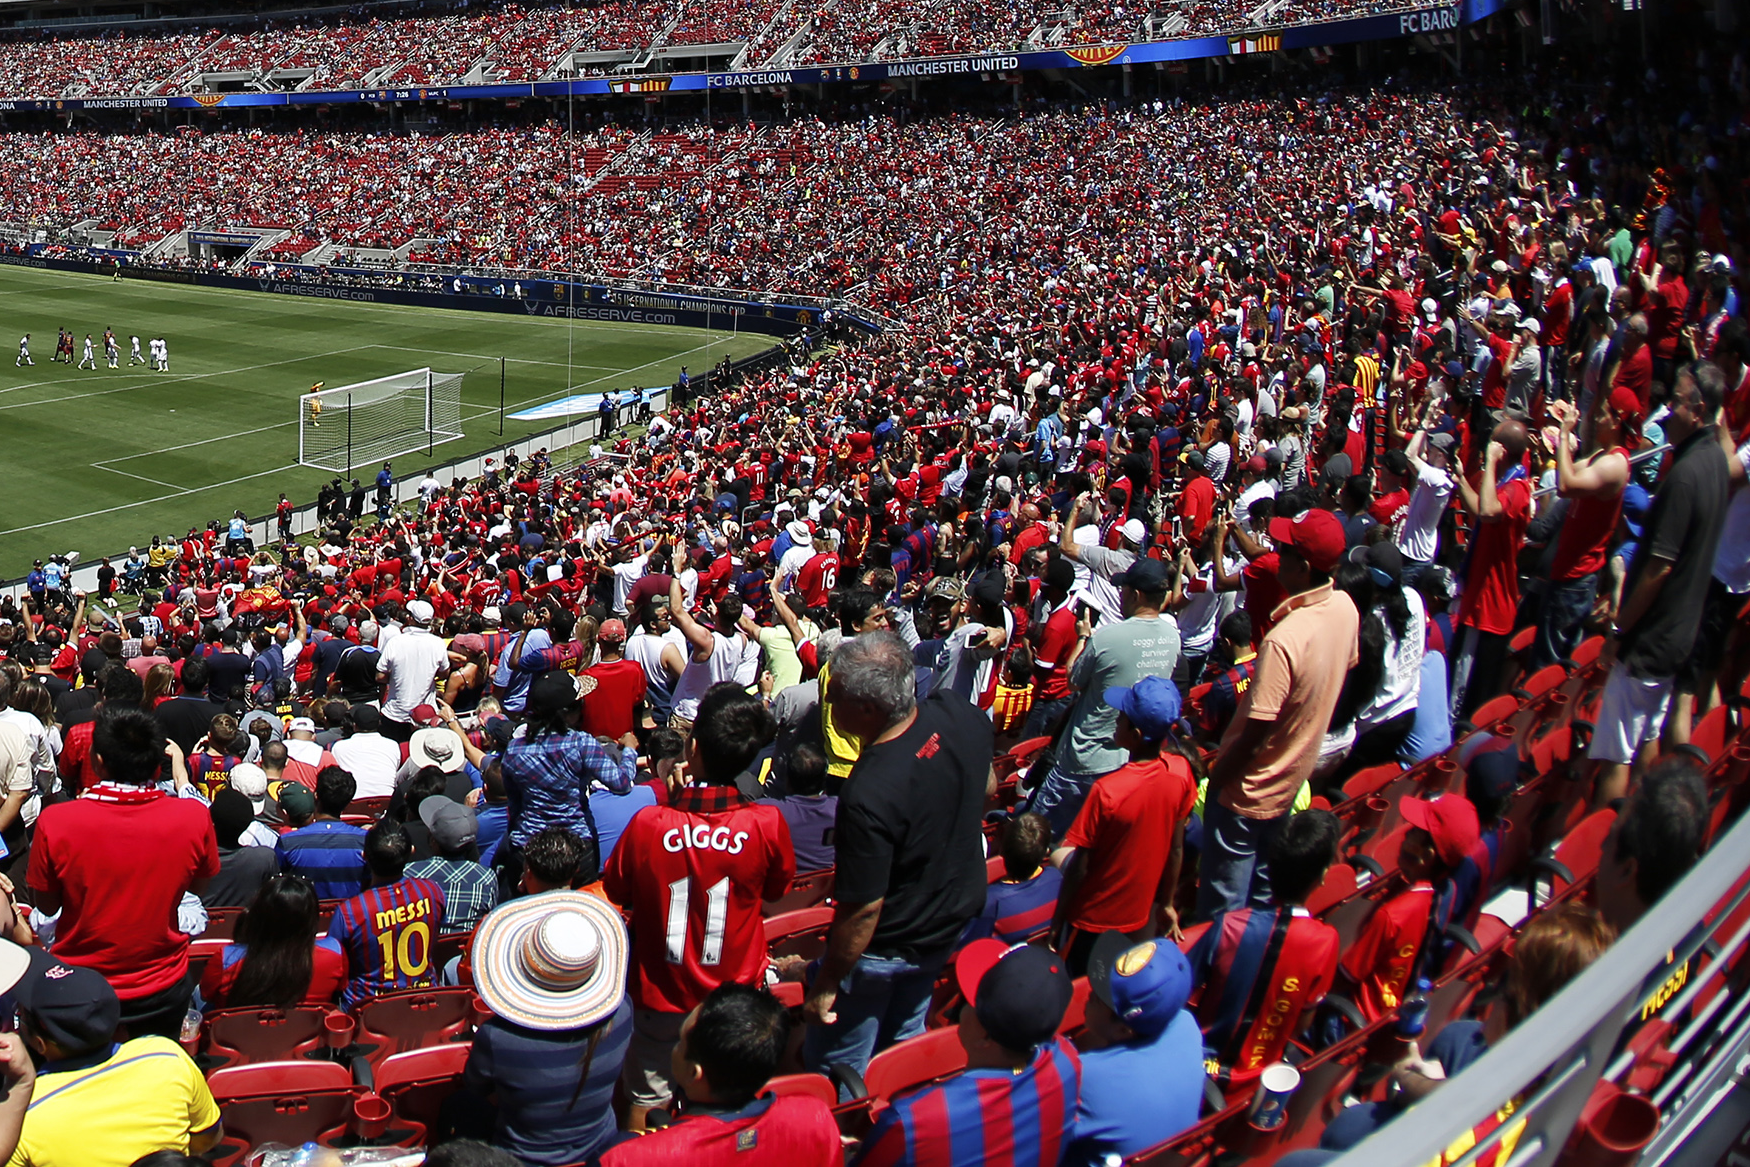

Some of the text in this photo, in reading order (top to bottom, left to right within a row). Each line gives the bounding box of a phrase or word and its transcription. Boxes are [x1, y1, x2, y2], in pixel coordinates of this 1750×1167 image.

[1400, 14, 1418, 34] FC
[888, 57, 1018, 77] MANCHESTER UNITED
[707, 72, 792, 86] FC BARCELONA
[83, 99, 168, 109] MANCHESTER UNITED
[274, 284, 374, 301] AFRESERVE.com
[544, 305, 676, 324] AFRESERVE.com
[681, 300, 727, 314] CHAMPIONS
[822, 567, 835, 591] 16
[1133, 637, 1156, 648] soggy
[1142, 649, 1169, 658] survivor
[1136, 659, 1169, 669] challenge
[276, 705, 292, 714] MESSI
[663, 824, 749, 854] GIGGS
[376, 898, 430, 929] MESSI
[665, 875, 730, 966] 11
[378, 921, 430, 980] 10
[1282, 977, 1300, 992] S.
[1642, 960, 1688, 1021] MESSI
[1248, 999, 1290, 1069] GOMEZ
